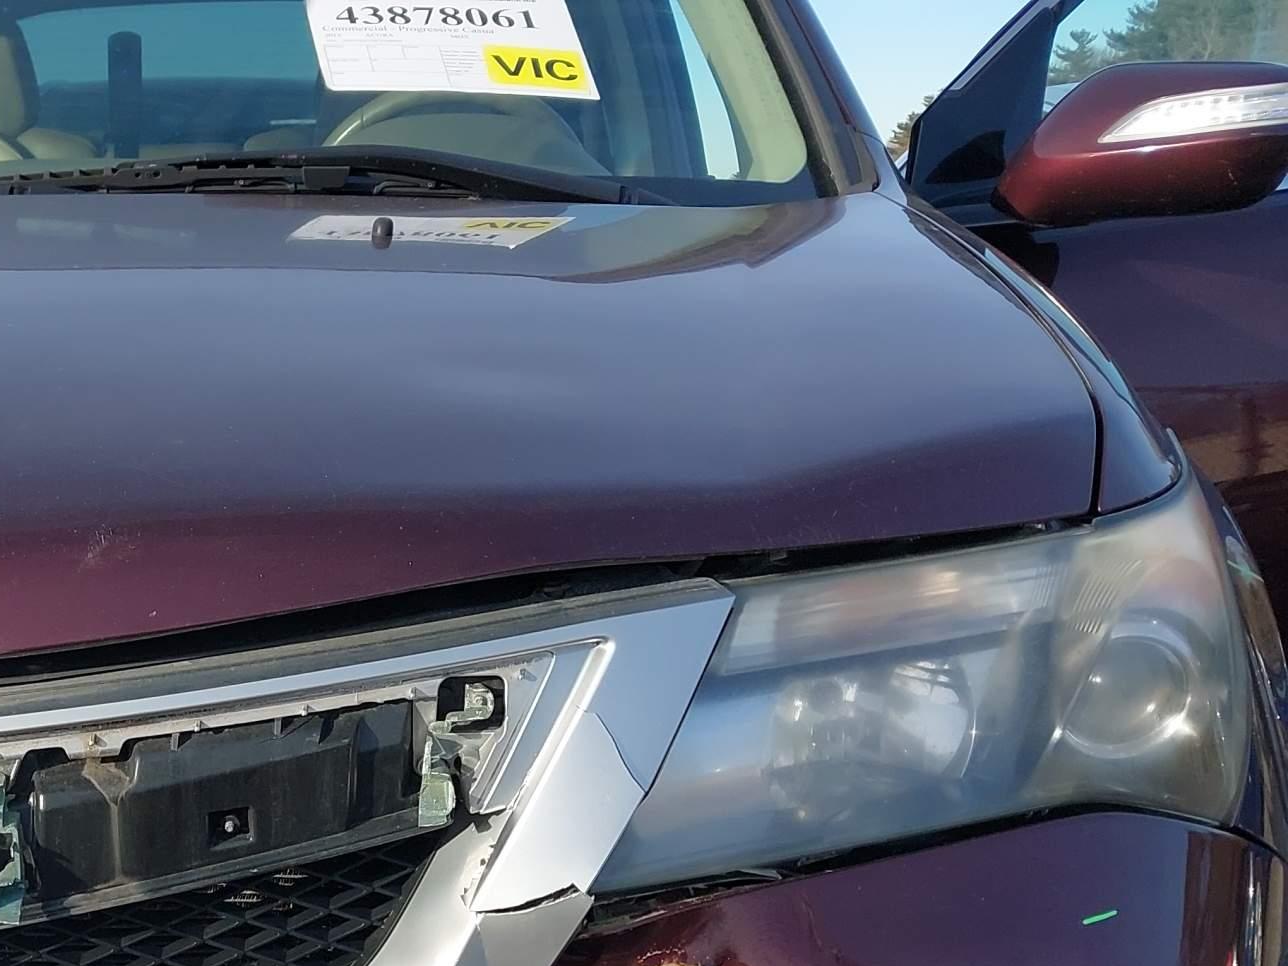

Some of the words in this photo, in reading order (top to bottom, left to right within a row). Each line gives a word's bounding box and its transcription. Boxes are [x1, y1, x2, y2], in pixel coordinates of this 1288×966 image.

[335, 5, 538, 29] 43878061
[398, 25, 460, 34] Progressive
[490, 54, 579, 82] VIC
